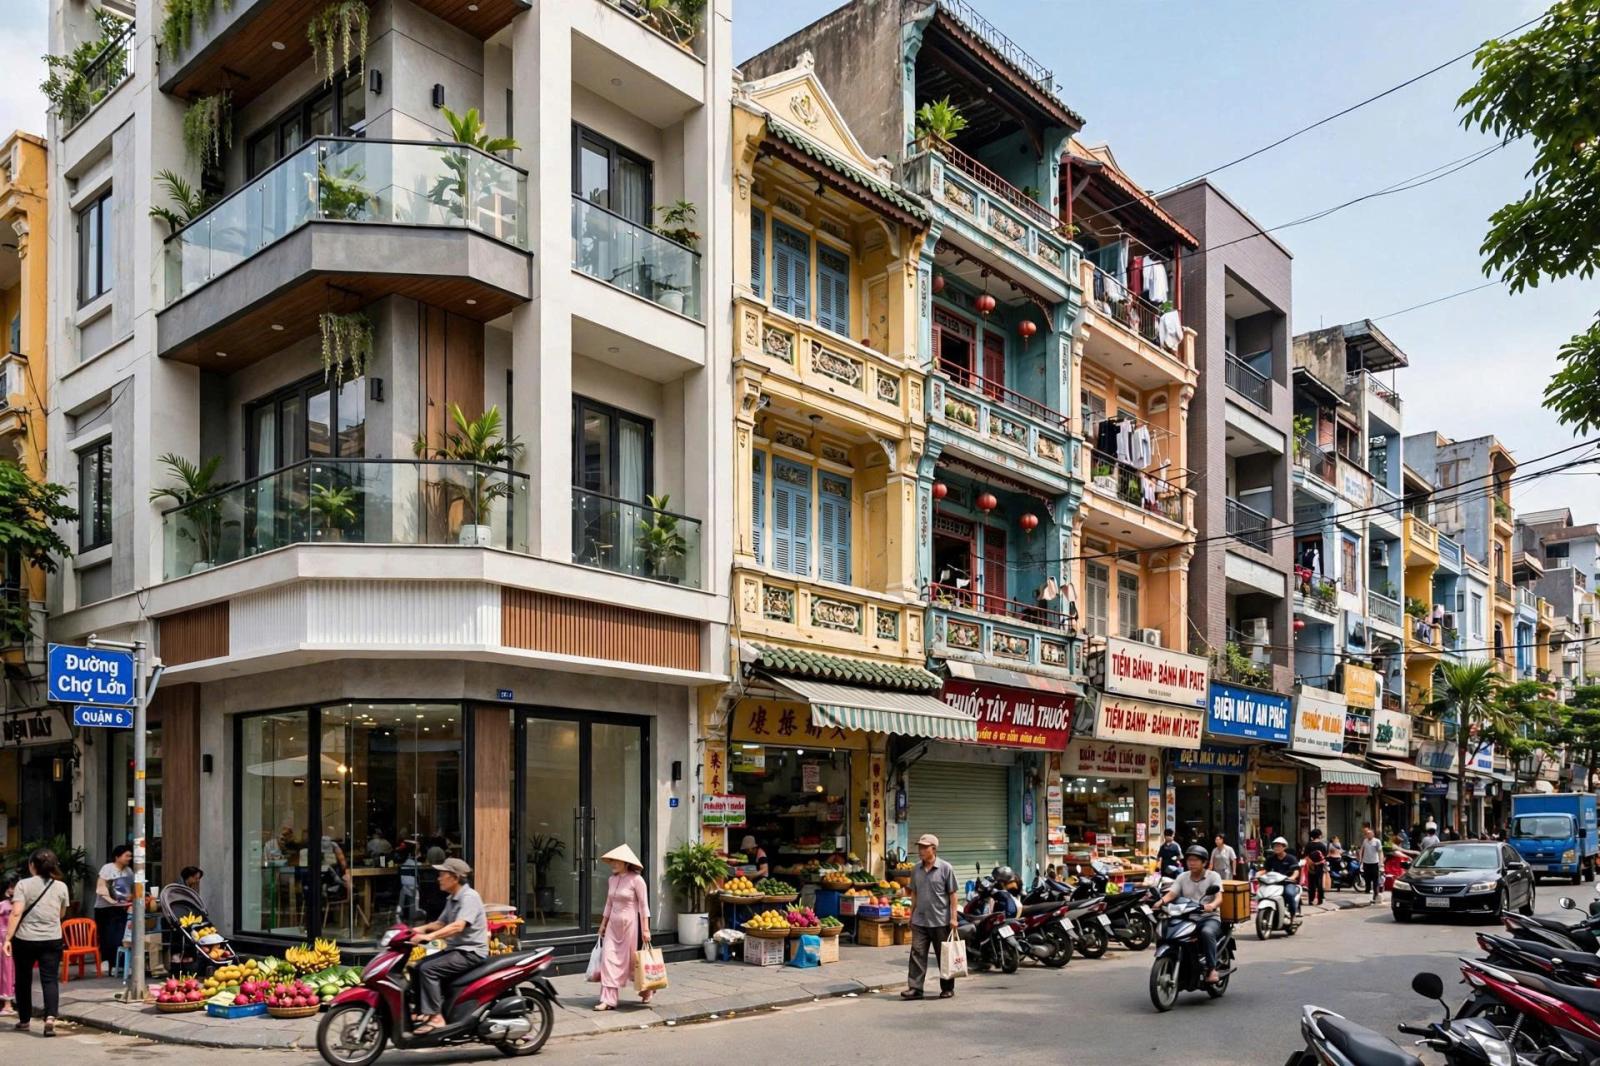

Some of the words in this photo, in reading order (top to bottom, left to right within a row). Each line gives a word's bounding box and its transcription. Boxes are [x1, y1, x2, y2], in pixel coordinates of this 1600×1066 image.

[64, 653, 119, 678] Đường
[1132, 654, 1153, 682] BÁNH
[1158, 660, 1178, 687] BÁNH
[1178, 664, 1188, 689] MÌ
[1189, 670, 1205, 692] PATE
[58, 674, 93, 697] Chợ
[97, 678, 126, 695] Lớn
[82, 709, 113, 726] QUẬN
[115, 713, 123, 724] 6
[986, 694, 1007, 722] TÂY
[1012, 698, 1035, 727] NHÀ
[1037, 700, 1069, 731] THUỐC
[1125, 705, 1147, 732] BÁNH
[1151, 710, 1172, 736] BÁNH
[1172, 713, 1183, 738] MÌ
[1183, 718, 1200, 739] PATE
[1213, 690, 1235, 727] ĐIỆN
[1236, 694, 1255, 724] MÁY
[1255, 703, 1267, 727] AN
[1268, 701, 1288, 729] PHÁT
